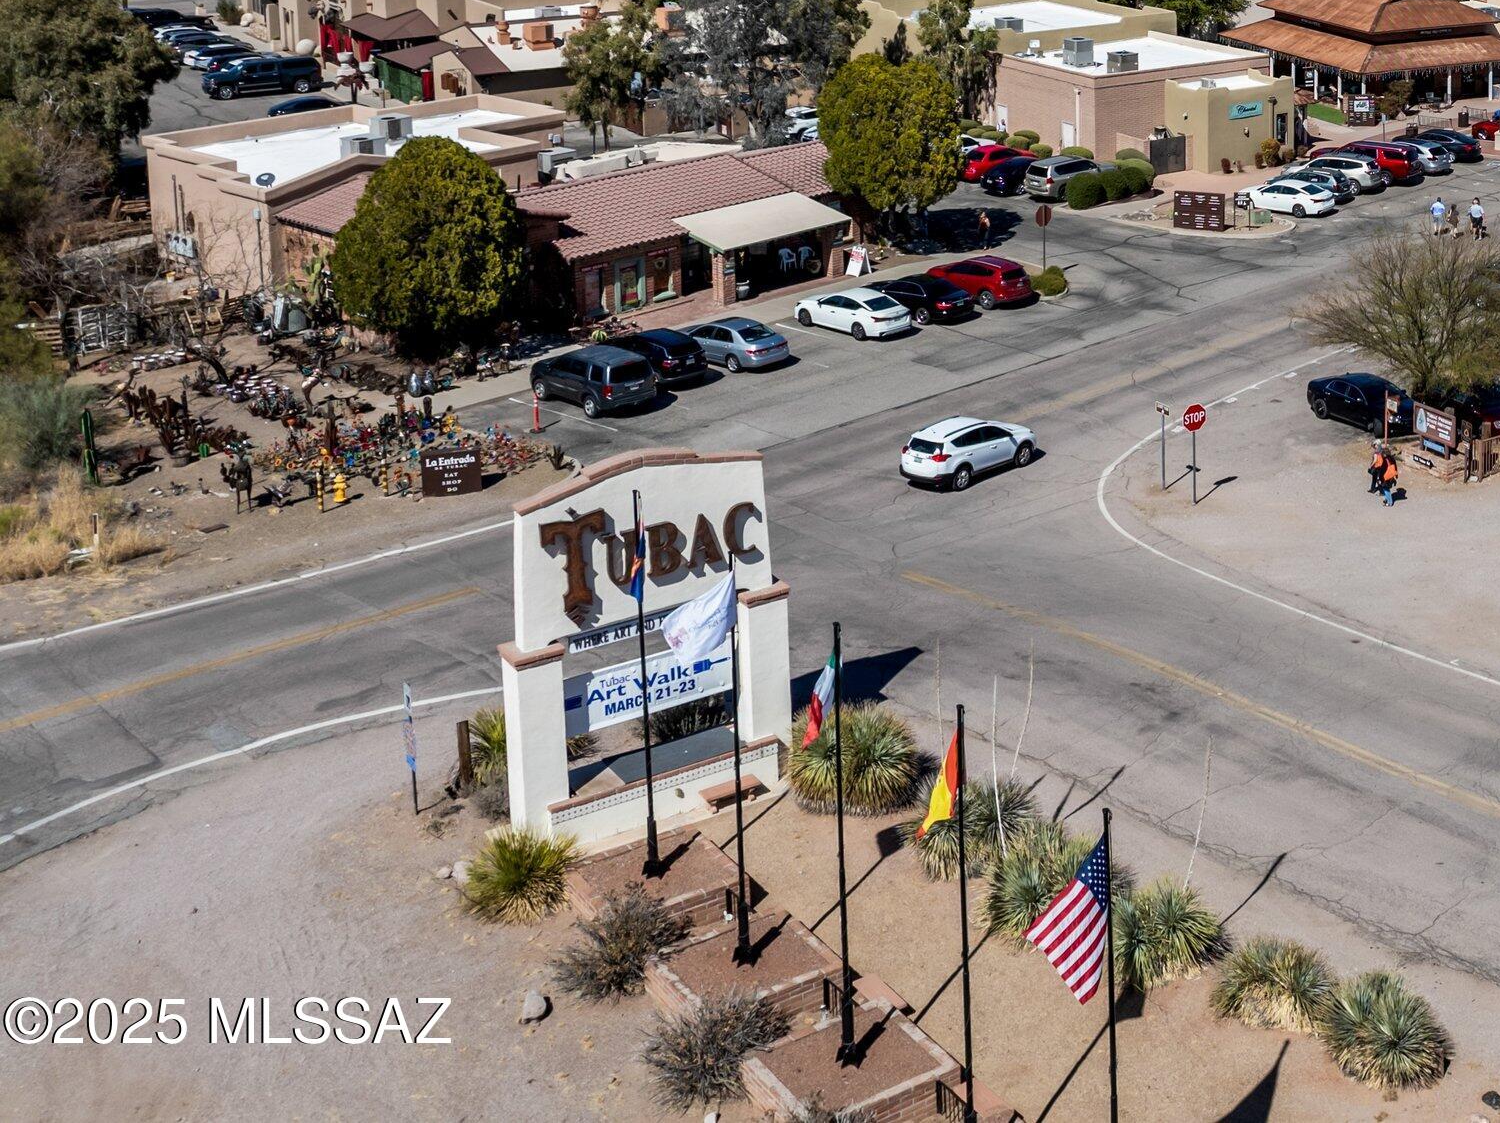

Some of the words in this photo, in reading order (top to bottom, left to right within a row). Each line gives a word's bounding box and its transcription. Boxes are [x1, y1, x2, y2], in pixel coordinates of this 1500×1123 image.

[1184, 411, 1206, 425] STOP
[425, 459, 437, 468] La
[438, 453, 476, 466] Entrada
[539, 502, 763, 617] TUBAC
[573, 630, 610, 650] WHERE
[613, 625, 632, 640] ART
[587, 685, 626, 706] Art
[633, 665, 690, 688] Walk
[599, 673, 631, 689] Tubac
[605, 689, 651, 716] MARCH
[655, 679, 696, 701] 21-23
